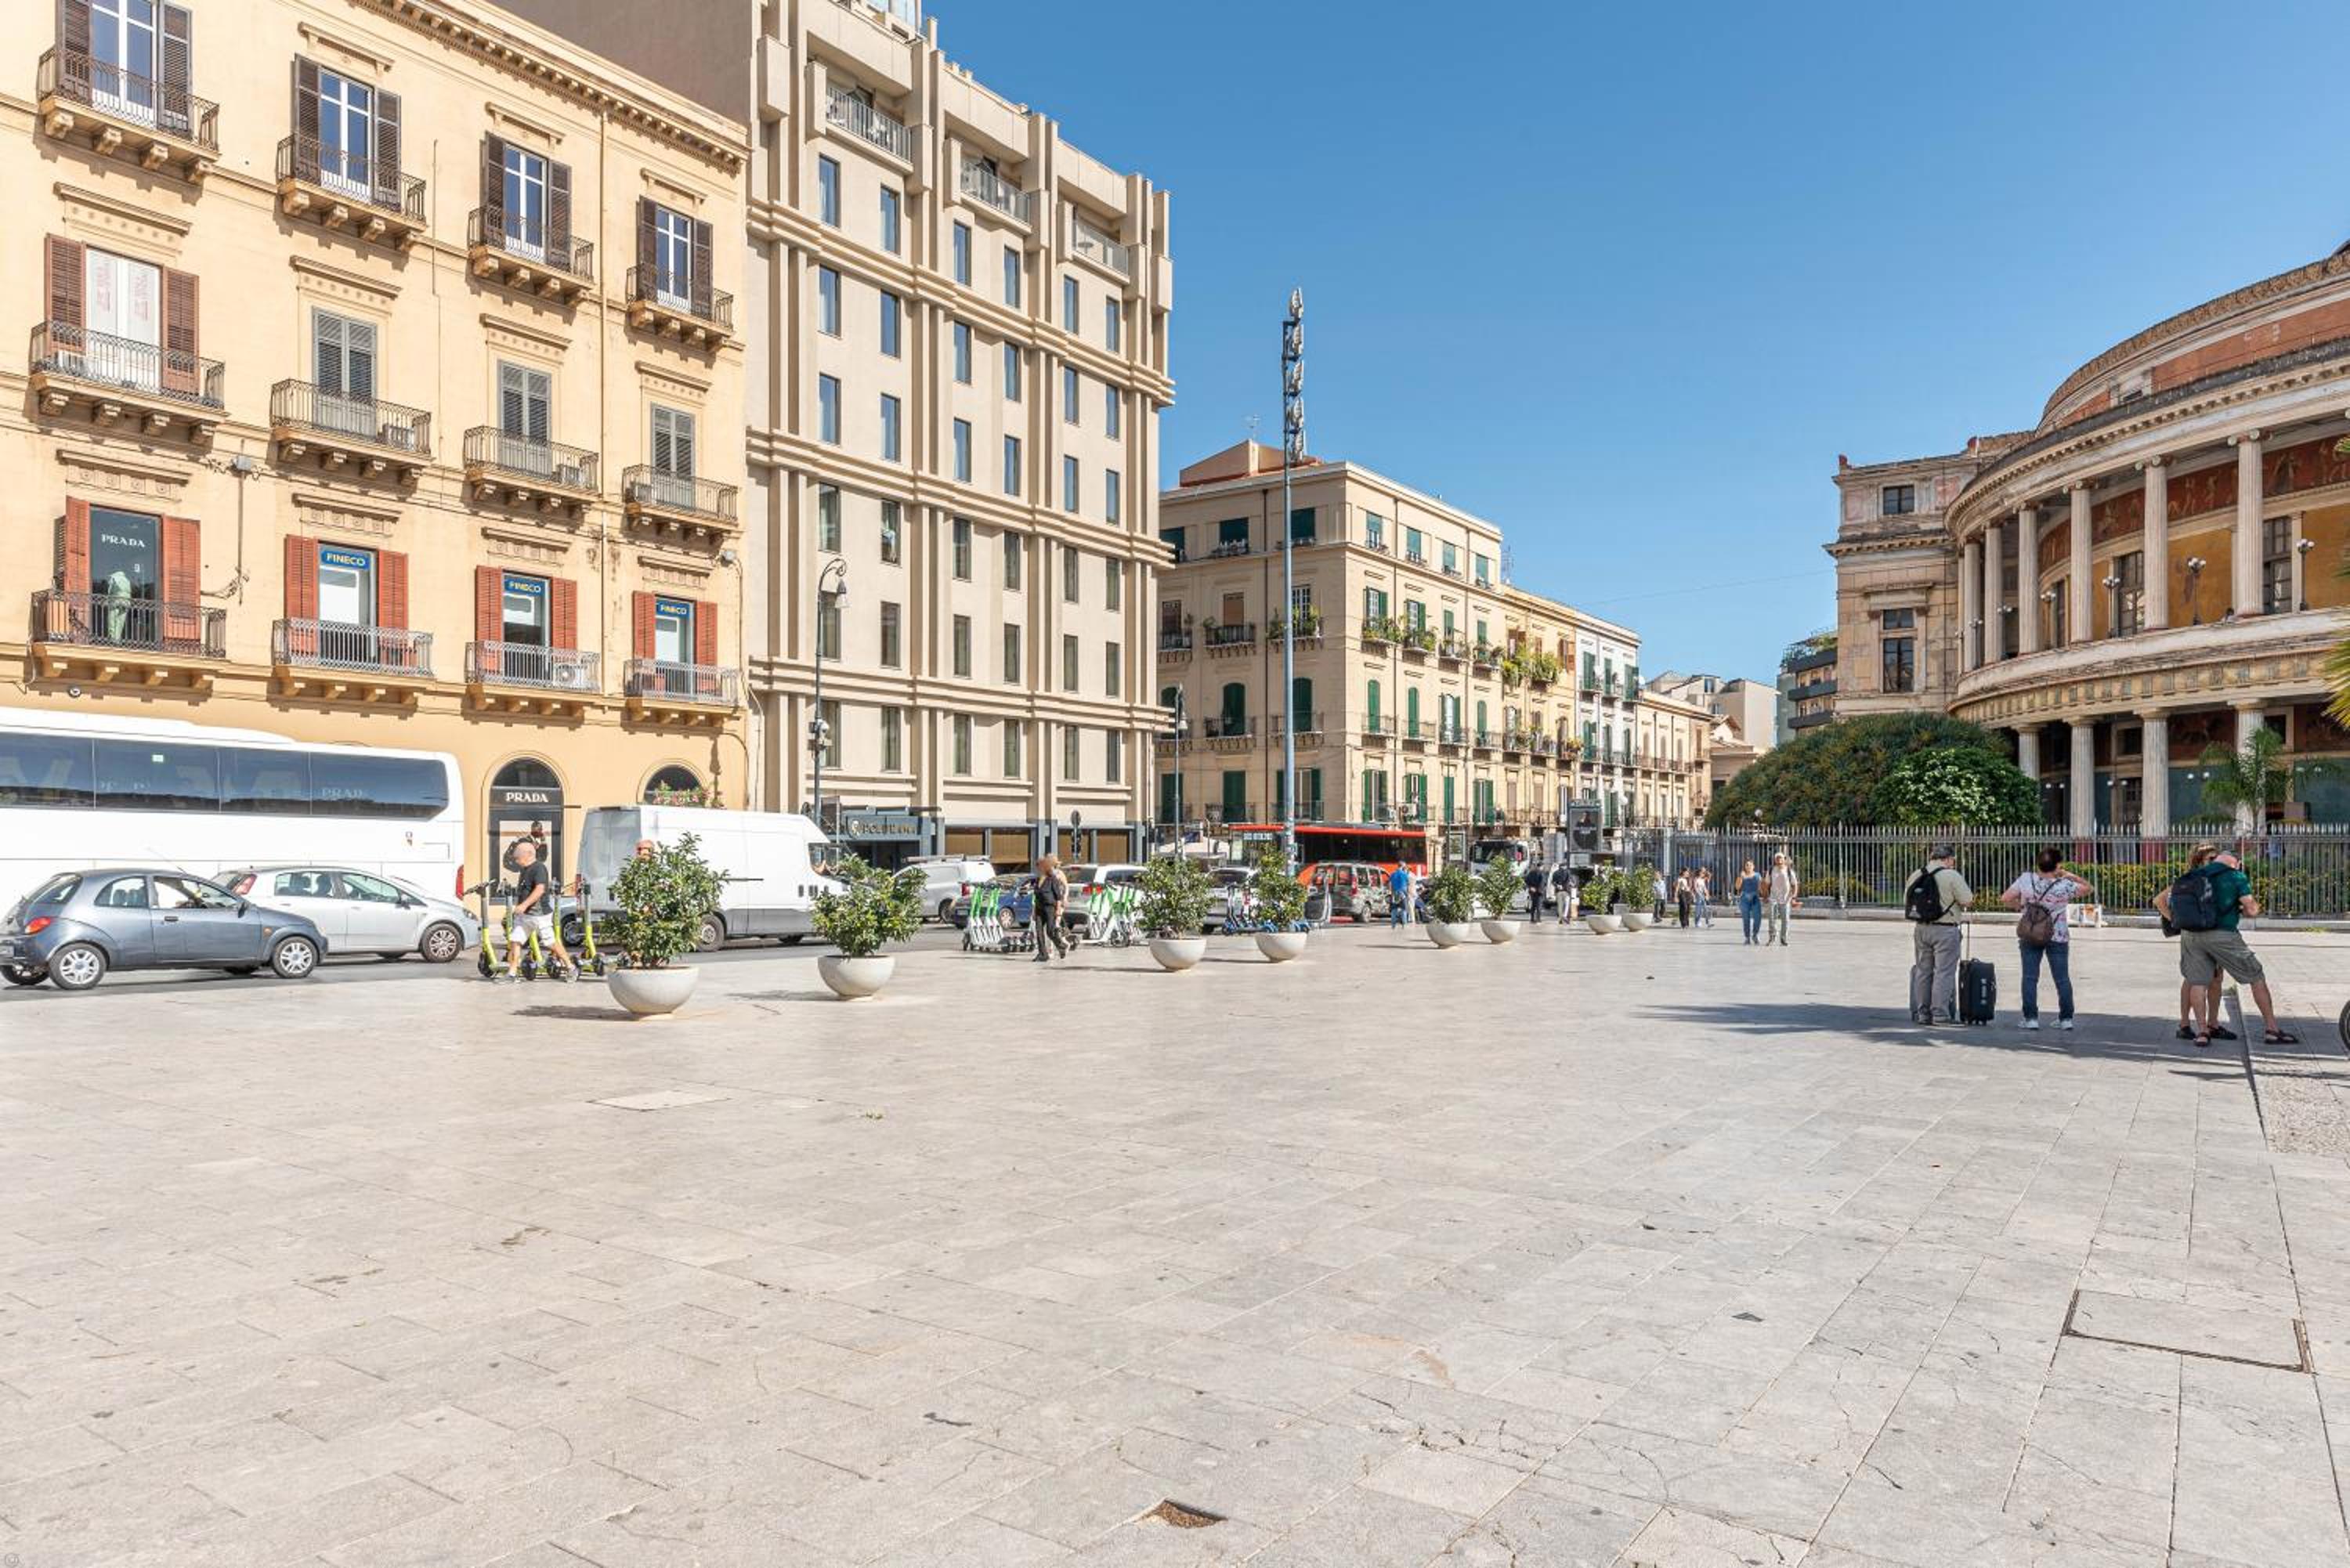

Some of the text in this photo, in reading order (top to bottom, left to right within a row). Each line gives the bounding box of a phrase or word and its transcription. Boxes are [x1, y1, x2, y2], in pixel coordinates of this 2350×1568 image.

[101, 533, 145, 547] PRADA
[327, 553, 366, 566] FINECO
[505, 792, 548, 803] PRADA
